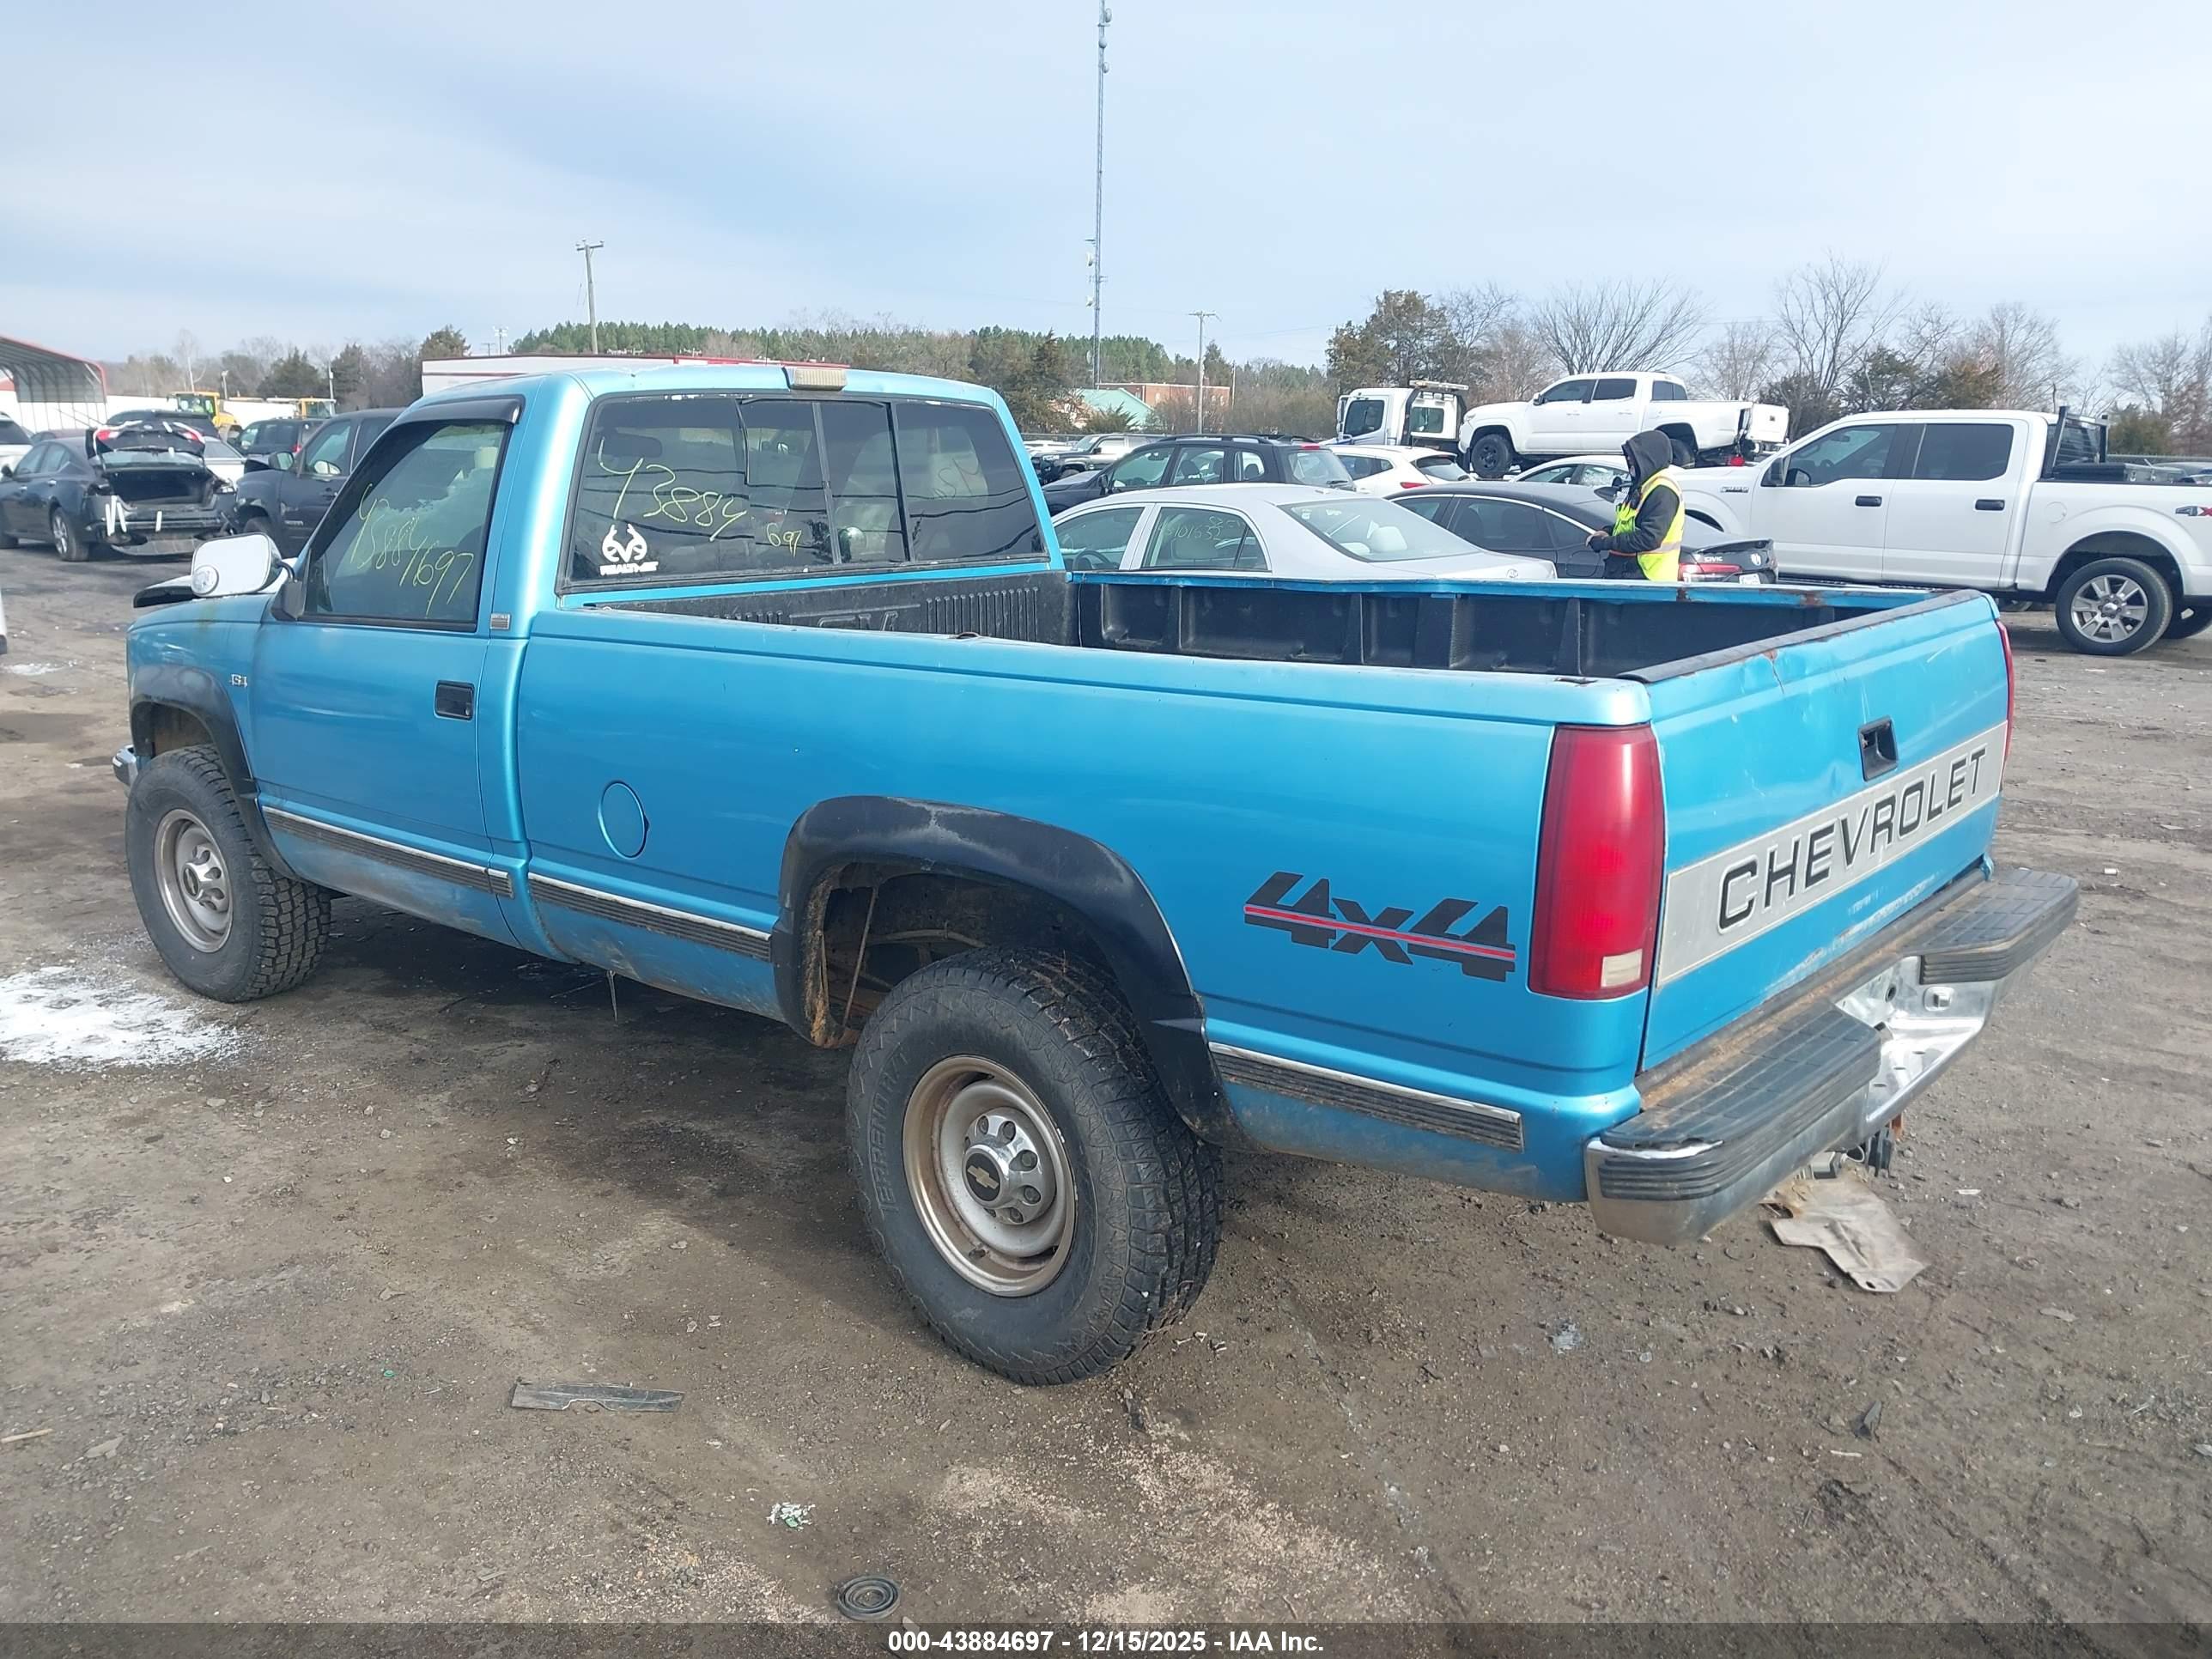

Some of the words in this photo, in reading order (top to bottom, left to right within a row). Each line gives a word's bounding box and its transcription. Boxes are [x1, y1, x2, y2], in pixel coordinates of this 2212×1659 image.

[599, 436, 747, 542] 43884
[767, 522, 802, 557] 697
[1719, 745, 1986, 932] CHEVROLET
